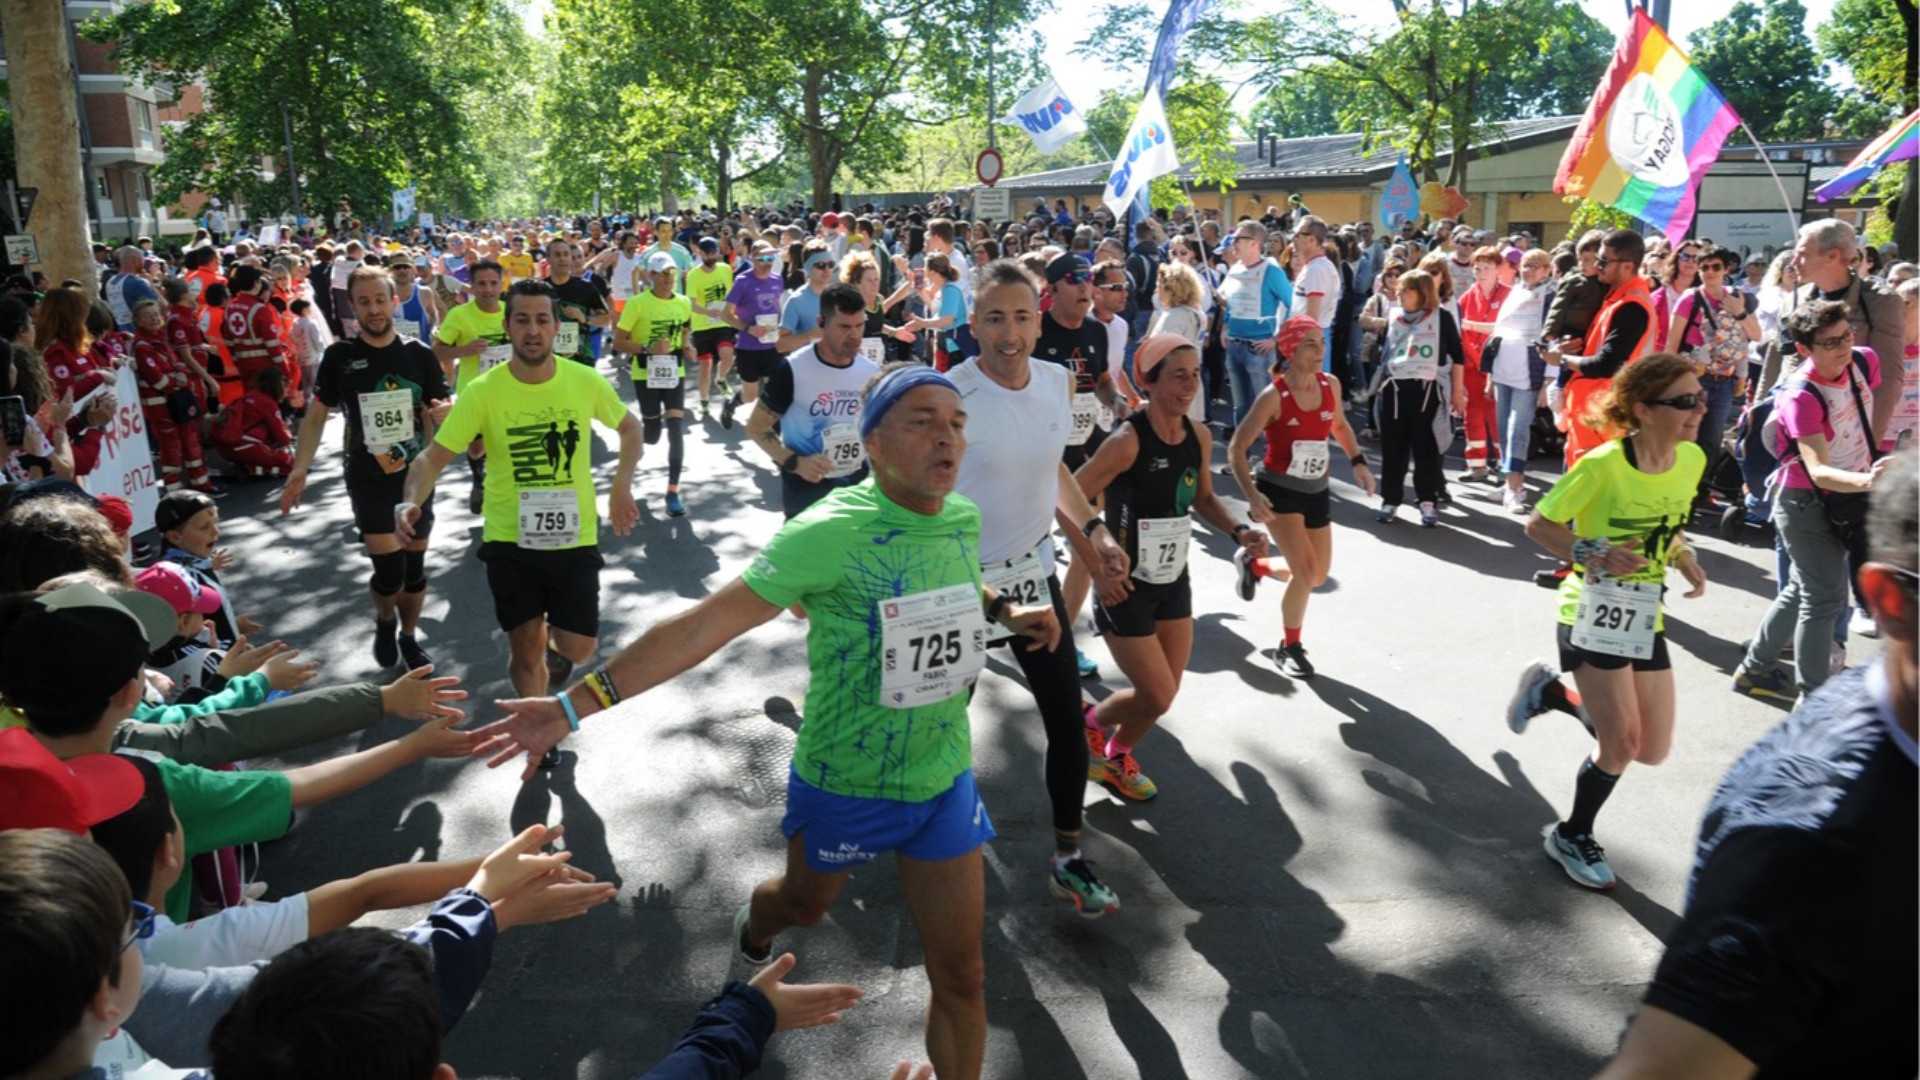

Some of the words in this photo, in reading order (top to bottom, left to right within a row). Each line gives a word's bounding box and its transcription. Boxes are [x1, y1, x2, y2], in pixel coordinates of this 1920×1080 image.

[374, 409, 403, 428] 864
[833, 442, 860, 460] 796
[1303, 458, 1326, 475] 164
[534, 511, 566, 531] 759
[1158, 542, 1177, 564] 72
[1593, 604, 1637, 632] 297
[909, 629, 962, 672] 725
